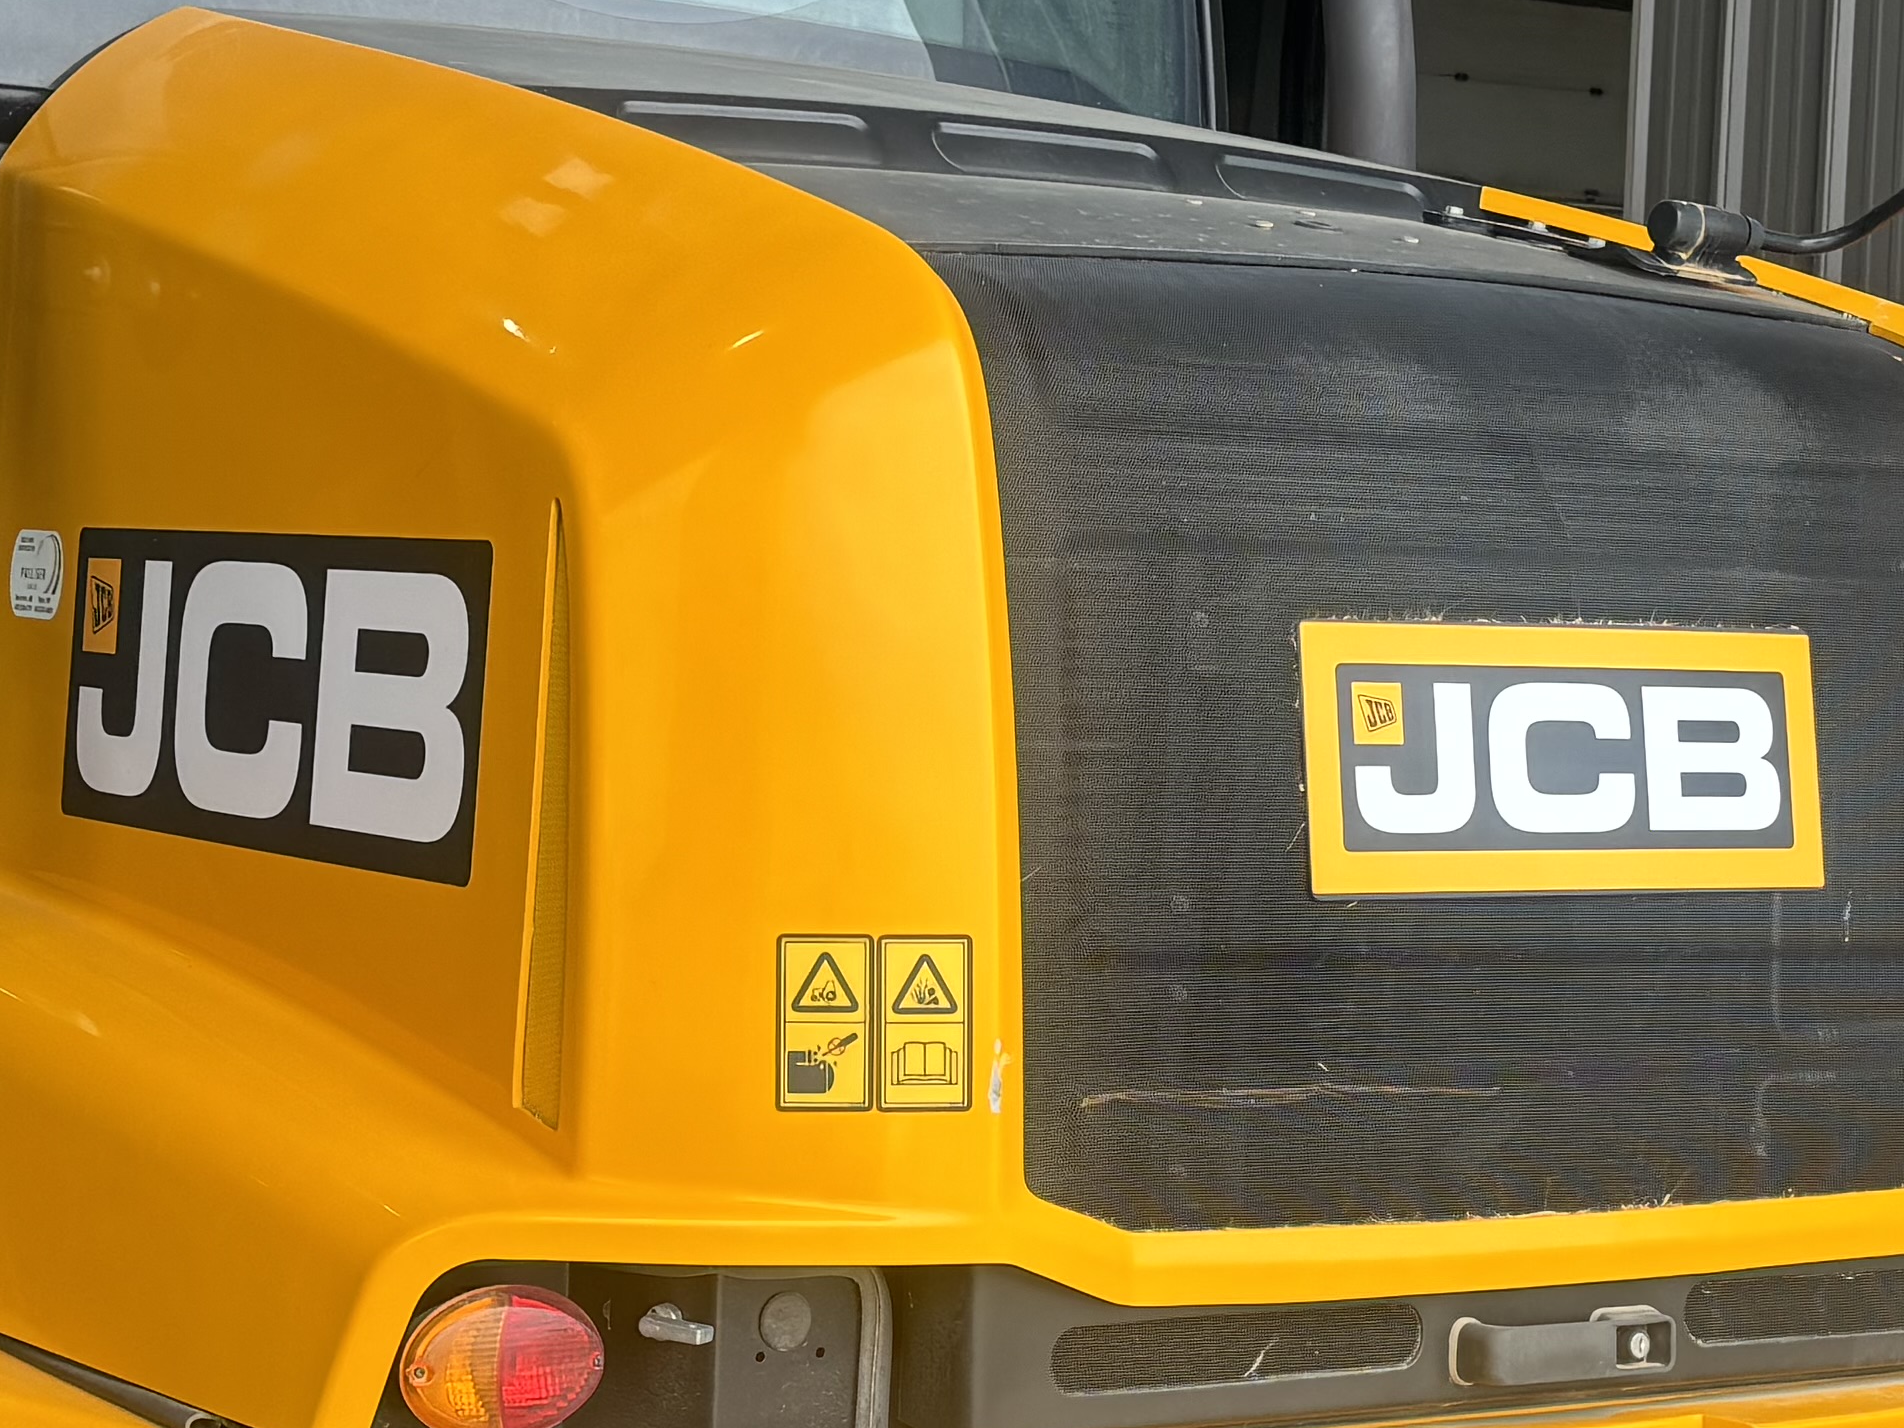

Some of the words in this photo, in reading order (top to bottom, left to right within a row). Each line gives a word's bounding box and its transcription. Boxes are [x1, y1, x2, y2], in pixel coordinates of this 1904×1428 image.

[76, 557, 470, 845] JCB
[1353, 682, 1783, 835] JCB
[1365, 699, 1394, 728] JCB
